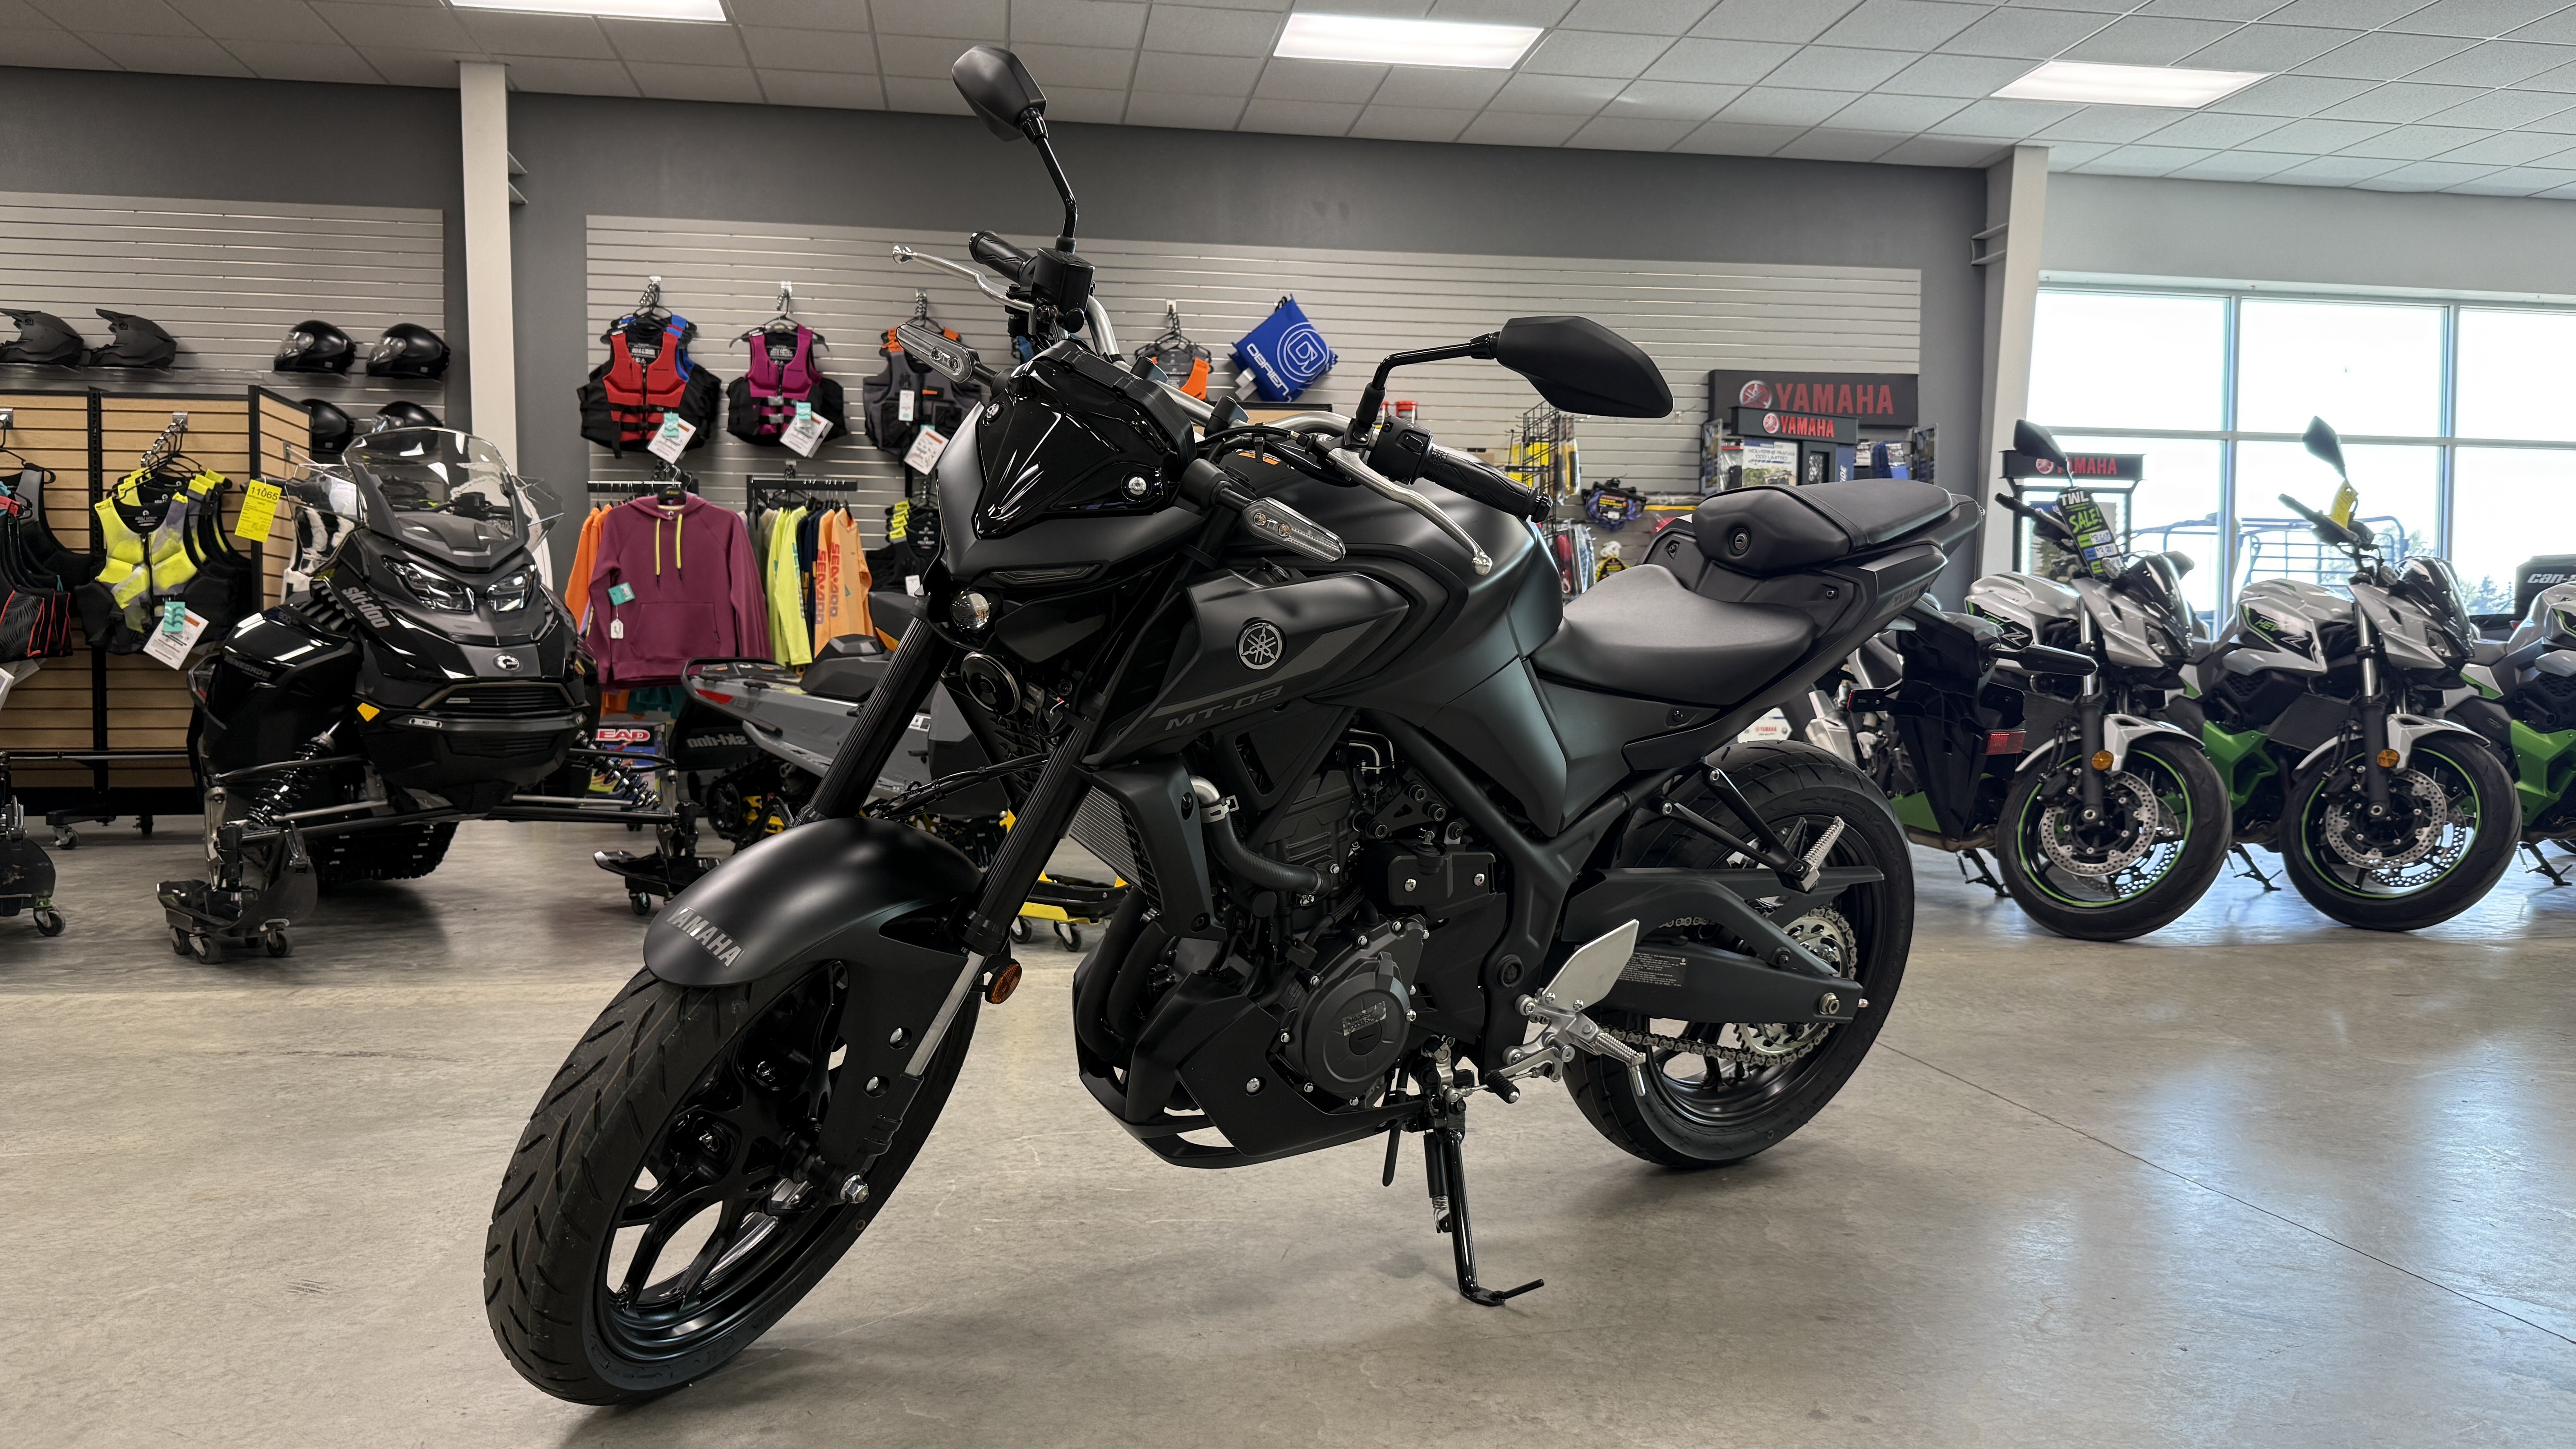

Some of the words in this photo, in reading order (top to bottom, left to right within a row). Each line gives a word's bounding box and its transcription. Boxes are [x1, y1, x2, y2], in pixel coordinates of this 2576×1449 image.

[1776, 382, 1894, 415] YAMAHA
[1780, 415, 1835, 438] YAMAHA
[2057, 456, 2117, 475] AMAHA
[251, 487, 279, 501] 11065
[2059, 491, 2089, 506] TWL
[2069, 506, 2102, 534] SALE!
[341, 587, 391, 628] ski-doo
[2254, 618, 2282, 632] HEV
[1165, 685, 1283, 731] MT-03
[596, 728, 651, 742] EAD
[667, 906, 742, 967] YAMAHA
